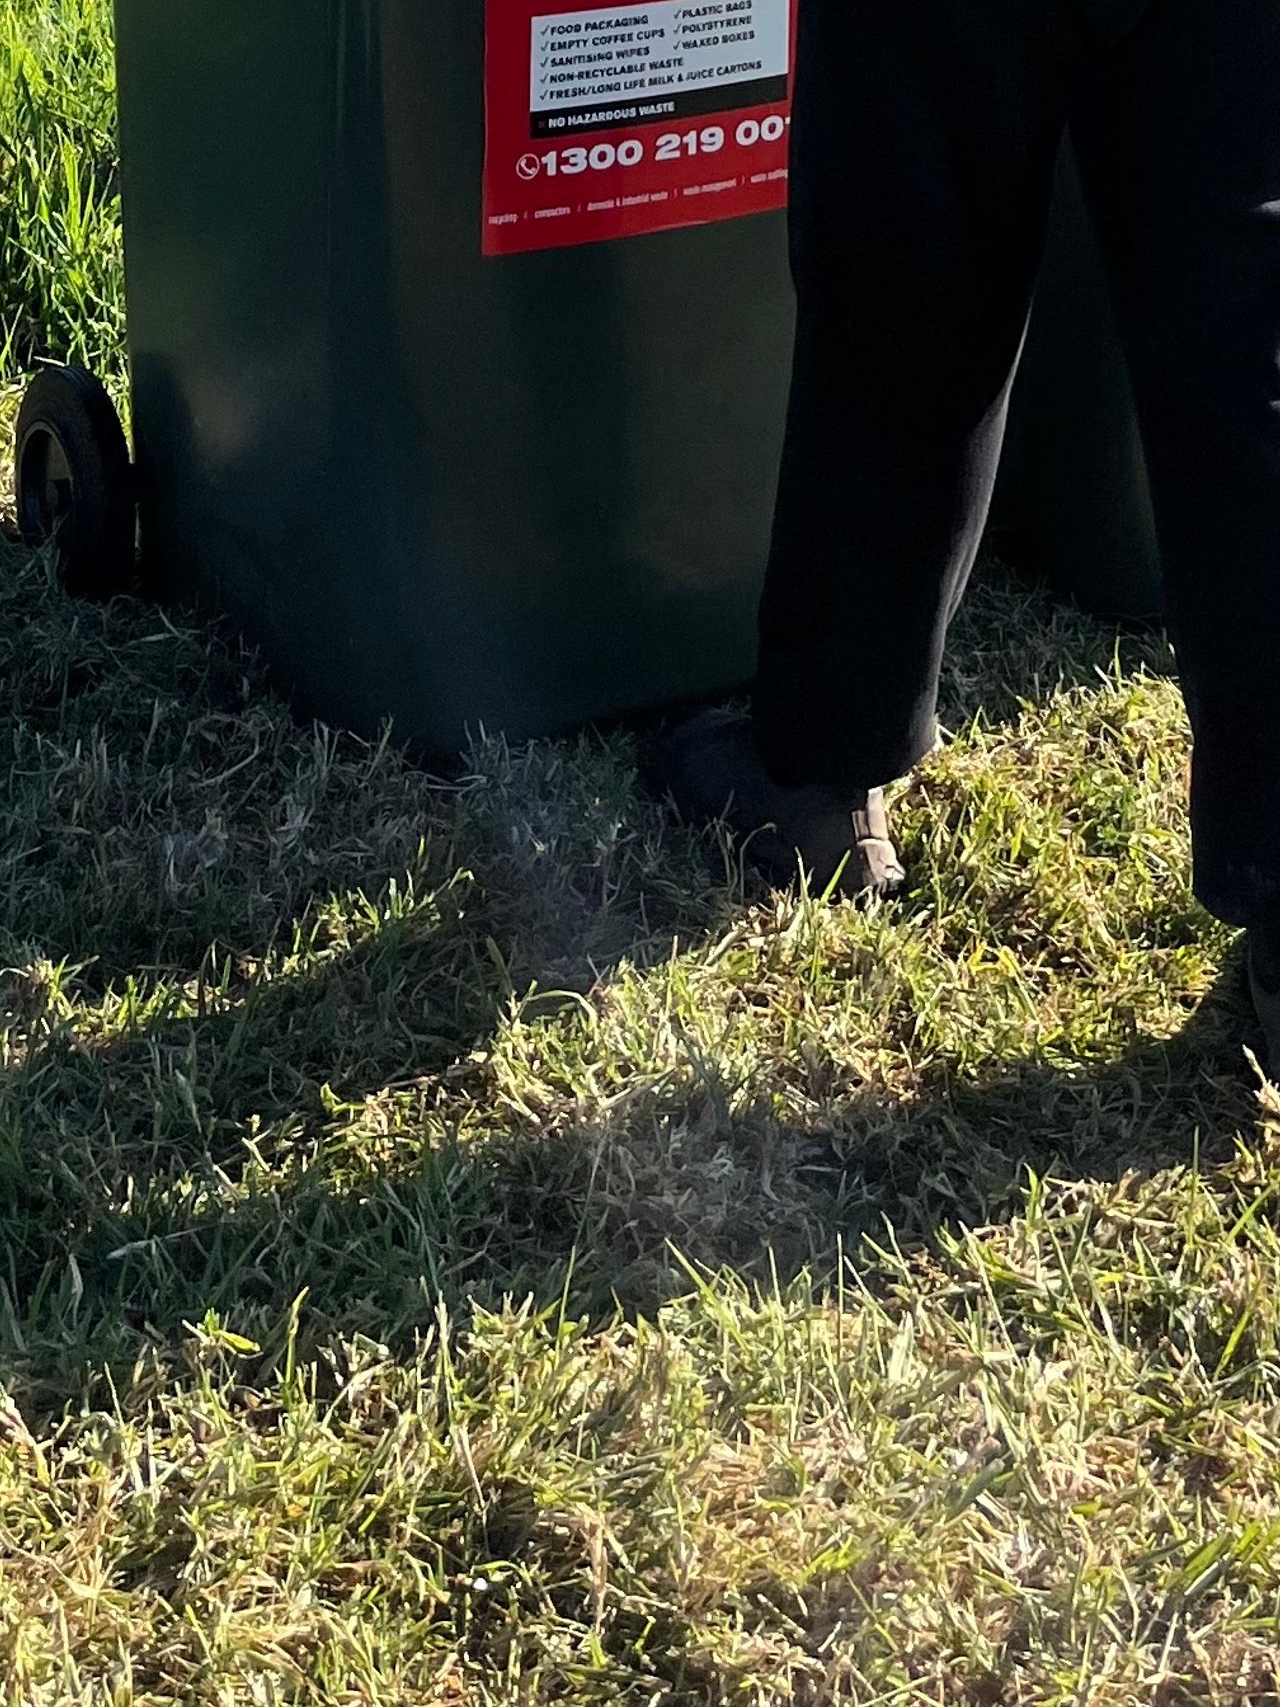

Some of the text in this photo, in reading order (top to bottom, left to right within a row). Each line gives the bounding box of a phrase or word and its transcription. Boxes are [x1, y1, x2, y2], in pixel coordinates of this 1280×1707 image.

[682, 0, 753, 19] PLASTIC BAGS
[550, 15, 649, 36] FOOD PACKAGING
[682, 15, 752, 34] POLYSTYRENE
[550, 28, 666, 51] EMPTY COFFEE CUPS
[682, 30, 755, 50] WAXED BOXES
[550, 47, 650, 67] SANITISING WIPES
[549, 57, 683, 83] NON-RECYCLABLE WASTE
[549, 82, 621, 99] FRESH/LONG
[624, 80, 646, 91] LIFE
[648, 74, 674, 87] MILK
[686, 67, 714, 81] JUICE
[716, 60, 762, 76] CARTONS
[548, 101, 675, 128] NO HAZARDOUS WASTE
[540, 114, 791, 177] 1300 219 00
